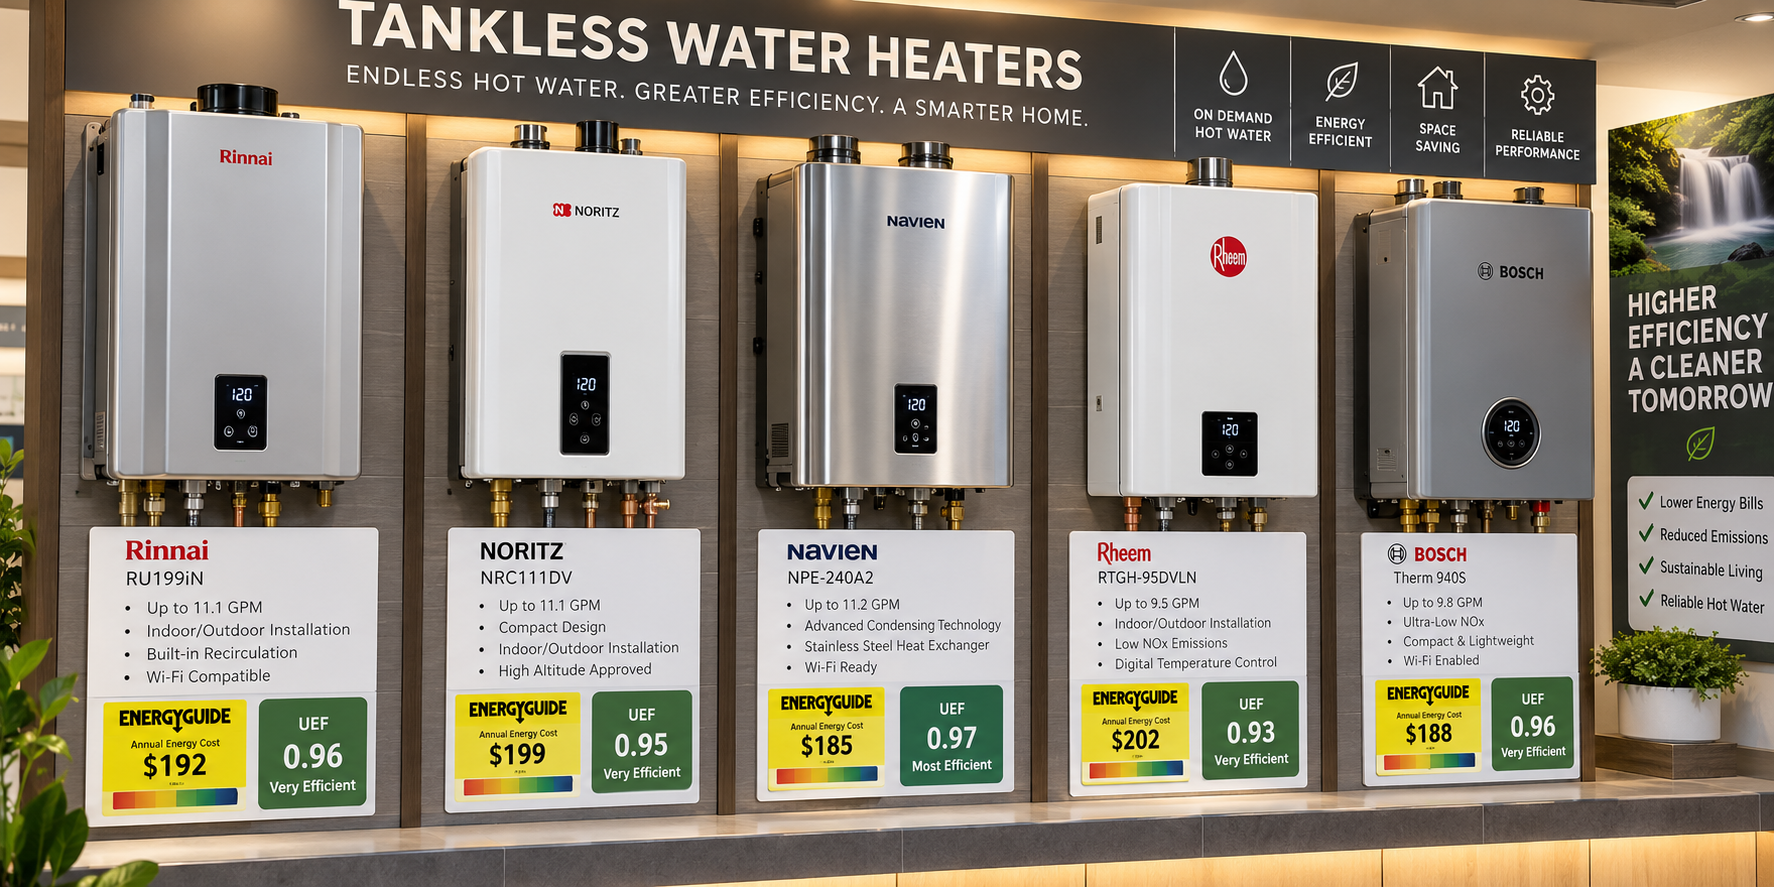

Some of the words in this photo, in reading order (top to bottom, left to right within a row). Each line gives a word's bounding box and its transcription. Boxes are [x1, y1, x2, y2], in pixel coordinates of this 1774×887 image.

[339, 0, 648, 62] TANKLESS
[667, 21, 850, 74] WATER
[869, 35, 1082, 90] HEATERS
[348, 65, 462, 89] ENDLESS
[475, 73, 525, 92] HOT
[535, 77, 624, 98] WATER.
[636, 83, 739, 105] GREATER
[751, 89, 883, 113] EFFICIENCY.
[893, 98, 906, 115] A
[916, 99, 1012, 121] SMARTER
[1023, 107, 1087, 126] HOME.
[1194, 109, 1212, 120] ON
[1218, 110, 1272, 123] DEMAND
[1316, 116, 1365, 129] ENERGY
[1196, 126, 1222, 138] HOT
[1227, 128, 1271, 141] WATER
[1420, 123, 1456, 136] SPACE
[1512, 129, 1564, 142] RELIABLE
[1309, 133, 1372, 147] EFFICIENT
[1416, 140, 1460, 153] SAVING
[220, 150, 272, 165] Rinnai
[1496, 145, 1579, 160] PERFORMANCE
[575, 206, 619, 217] NORITZ
[1214, 238, 1245, 271] Rheem
[1500, 266, 1543, 279] BOSCH
[1629, 285, 1716, 317] HIGHER
[1629, 313, 1768, 349] EFFICIENCY
[1628, 357, 1644, 381] A
[1651, 349, 1762, 379] CLEANER
[577, 378, 596, 391] 120
[233, 388, 252, 401] 120
[1629, 382, 1773, 412] TOMORROW
[909, 399, 925, 411] 120
[1223, 424, 1238, 436] 120
[1505, 420, 1519, 432] 120
[1661, 496, 1693, 508] Lower
[1697, 496, 1735, 512] Energy
[1740, 496, 1763, 509] Bills
[1661, 528, 1707, 542] Reduced
[1712, 530, 1768, 544] Emissions
[126, 540, 208, 560] Rinnai
[481, 542, 563, 560] NORITZ
[1098, 542, 1151, 565] Rheem
[1415, 547, 1466, 562] BOSCH
[127, 571, 202, 585] RU199iN
[482, 571, 572, 584] NRC111DV
[789, 571, 873, 584] NPE-240A2
[1099, 571, 1196, 584] RTGH-95DVLN
[1394, 572, 1432, 583] Therm
[1437, 571, 1466, 583] 940S
[1661, 561, 1724, 576] Sustainable
[1729, 564, 1762, 582] Living
[148, 602, 168, 617] Up
[174, 603, 188, 614] to
[195, 602, 220, 613] 11.1
[228, 601, 261, 613] GPM
[500, 600, 517, 614] Up
[523, 601, 535, 611] to
[541, 600, 563, 611] 11.1
[570, 599, 600, 611] GPM
[806, 599, 822, 612] Up
[826, 600, 838, 610] to
[844, 599, 867, 610] 11.2
[872, 599, 899, 610] GPM
[1116, 598, 1131, 611] Up
[1136, 599, 1147, 609] to
[1151, 598, 1168, 609] 9.5
[1172, 598, 1199, 608] GPM
[1404, 597, 1418, 610] Up
[1423, 598, 1433, 607] to
[1437, 597, 1453, 607] 9.8
[1457, 597, 1482, 607] GPM
[1661, 594, 1703, 609] Reliable
[1707, 597, 1727, 611] Hot
[1730, 599, 1764, 614] Water
[500, 622, 557, 635] Compact
[563, 621, 605, 635] Design
[805, 620, 863, 631] Advanced
[867, 620, 934, 633] Condensing
[938, 619, 1001, 632] Technology
[1116, 618, 1206, 629] Indoor/Outdoor
[1211, 617, 1271, 628] Installation
[1404, 617, 1457, 627] Ultra-Low
[1461, 616, 1484, 626] NOx
[148, 624, 264, 637] Indoor/Outdoor
[271, 623, 349, 635] Installation
[500, 642, 604, 655] Indoor/Outdoor
[609, 642, 678, 653] Installation
[805, 640, 859, 652] Stainless
[864, 640, 892, 651] Steel
[897, 640, 924, 651] Heat
[929, 640, 989, 653] Exchanger
[1116, 639, 1139, 649] Low
[1144, 638, 1167, 649] NOx
[1172, 638, 1227, 648] Emissions
[1404, 636, 1453, 648] Compact
[1457, 636, 1465, 646] &
[1470, 635, 1534, 648] Lightweight
[148, 647, 198, 660] Built-in
[205, 646, 297, 659] Recirculation
[1116, 658, 1152, 672] Digital
[1157, 658, 1231, 671] Temperature
[1235, 656, 1276, 667] Control
[1404, 655, 1431, 666] Wi-Fi
[1436, 655, 1479, 665] Enabled
[500, 664, 529, 680] High
[534, 664, 585, 676] Altitude
[590, 663, 651, 678] Approved
[805, 661, 835, 673] Wi-Fi
[841, 661, 877, 675] Ready
[147, 671, 183, 683] Wi-Fi
[189, 669, 270, 685] Compatible
[1093, 690, 1177, 711] ENERGYGUIDE
[1388, 685, 1469, 706] ENERGYGUIDE
[1522, 693, 1544, 704] UEF
[781, 695, 872, 716] ENERGYGUIDE
[940, 703, 965, 715] UEF
[1240, 698, 1263, 710] UEF
[470, 700, 567, 723] ENERGYGUIDE
[629, 708, 655, 721] UEF
[1422, 712, 1445, 720] Energy
[120, 708, 230, 733] ENERGYGUIDE
[299, 717, 328, 730] UEF
[819, 722, 845, 731] Energy
[1129, 717, 1153, 726] Energy
[1511, 716, 1555, 737] 0.96
[479, 730, 507, 738] Annual
[510, 730, 537, 739] Energy
[540, 729, 557, 737] Cost
[928, 726, 976, 749] 0.97
[1228, 721, 1274, 743] 0.93
[1407, 723, 1452, 745] $188
[131, 740, 162, 748] Annual
[166, 740, 197, 749] Energy
[200, 739, 220, 747] Cost
[615, 733, 667, 757] 0.95
[802, 735, 852, 757] $185
[1113, 729, 1159, 752] $202
[284, 743, 342, 769] 0.96
[490, 743, 545, 767] $199
[1501, 748, 1523, 759] Very
[1527, 746, 1566, 756] Efficient
[144, 753, 206, 779] $192
[913, 761, 941, 771] Most
[945, 759, 992, 770] Efficient
[1215, 755, 1240, 767] Very
[1244, 753, 1288, 764] Efficient
[604, 769, 630, 781] Very
[634, 766, 681, 778] Efficient
[270, 782, 299, 795] Very
[304, 779, 356, 792] Efficient
